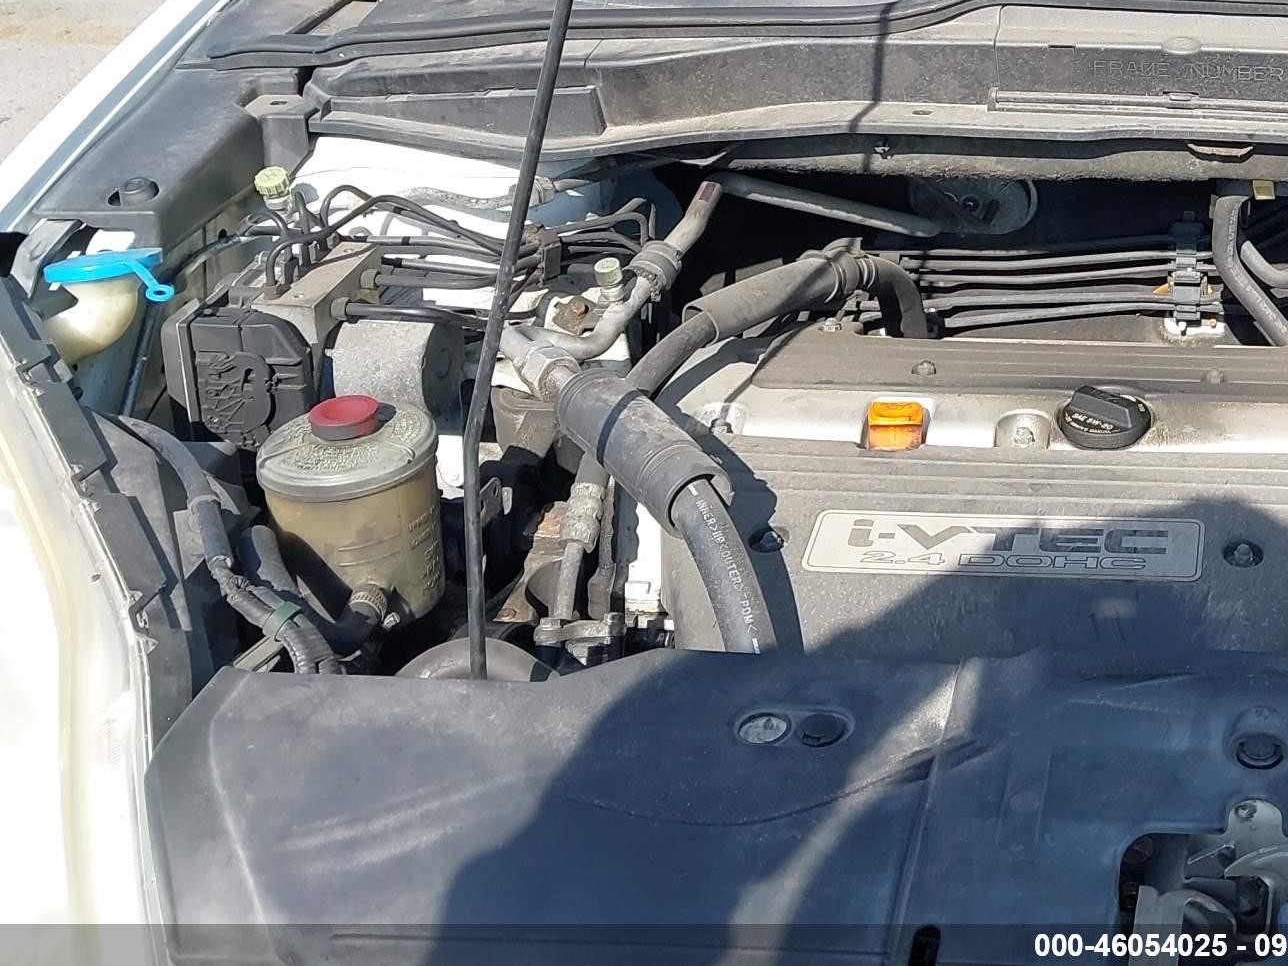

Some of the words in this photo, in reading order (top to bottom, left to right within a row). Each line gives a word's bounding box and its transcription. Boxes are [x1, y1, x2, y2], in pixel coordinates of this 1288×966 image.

[1093, 59, 1171, 78] FRAME
[1189, 61, 1285, 82] NUMBER
[1071, 412, 1088, 422] SAE
[1086, 417, 1114, 430] 5W-20
[846, 517, 1169, 555] i-VTEC
[858, 550, 946, 566] 2.4
[957, 552, 1147, 570] DOHC
